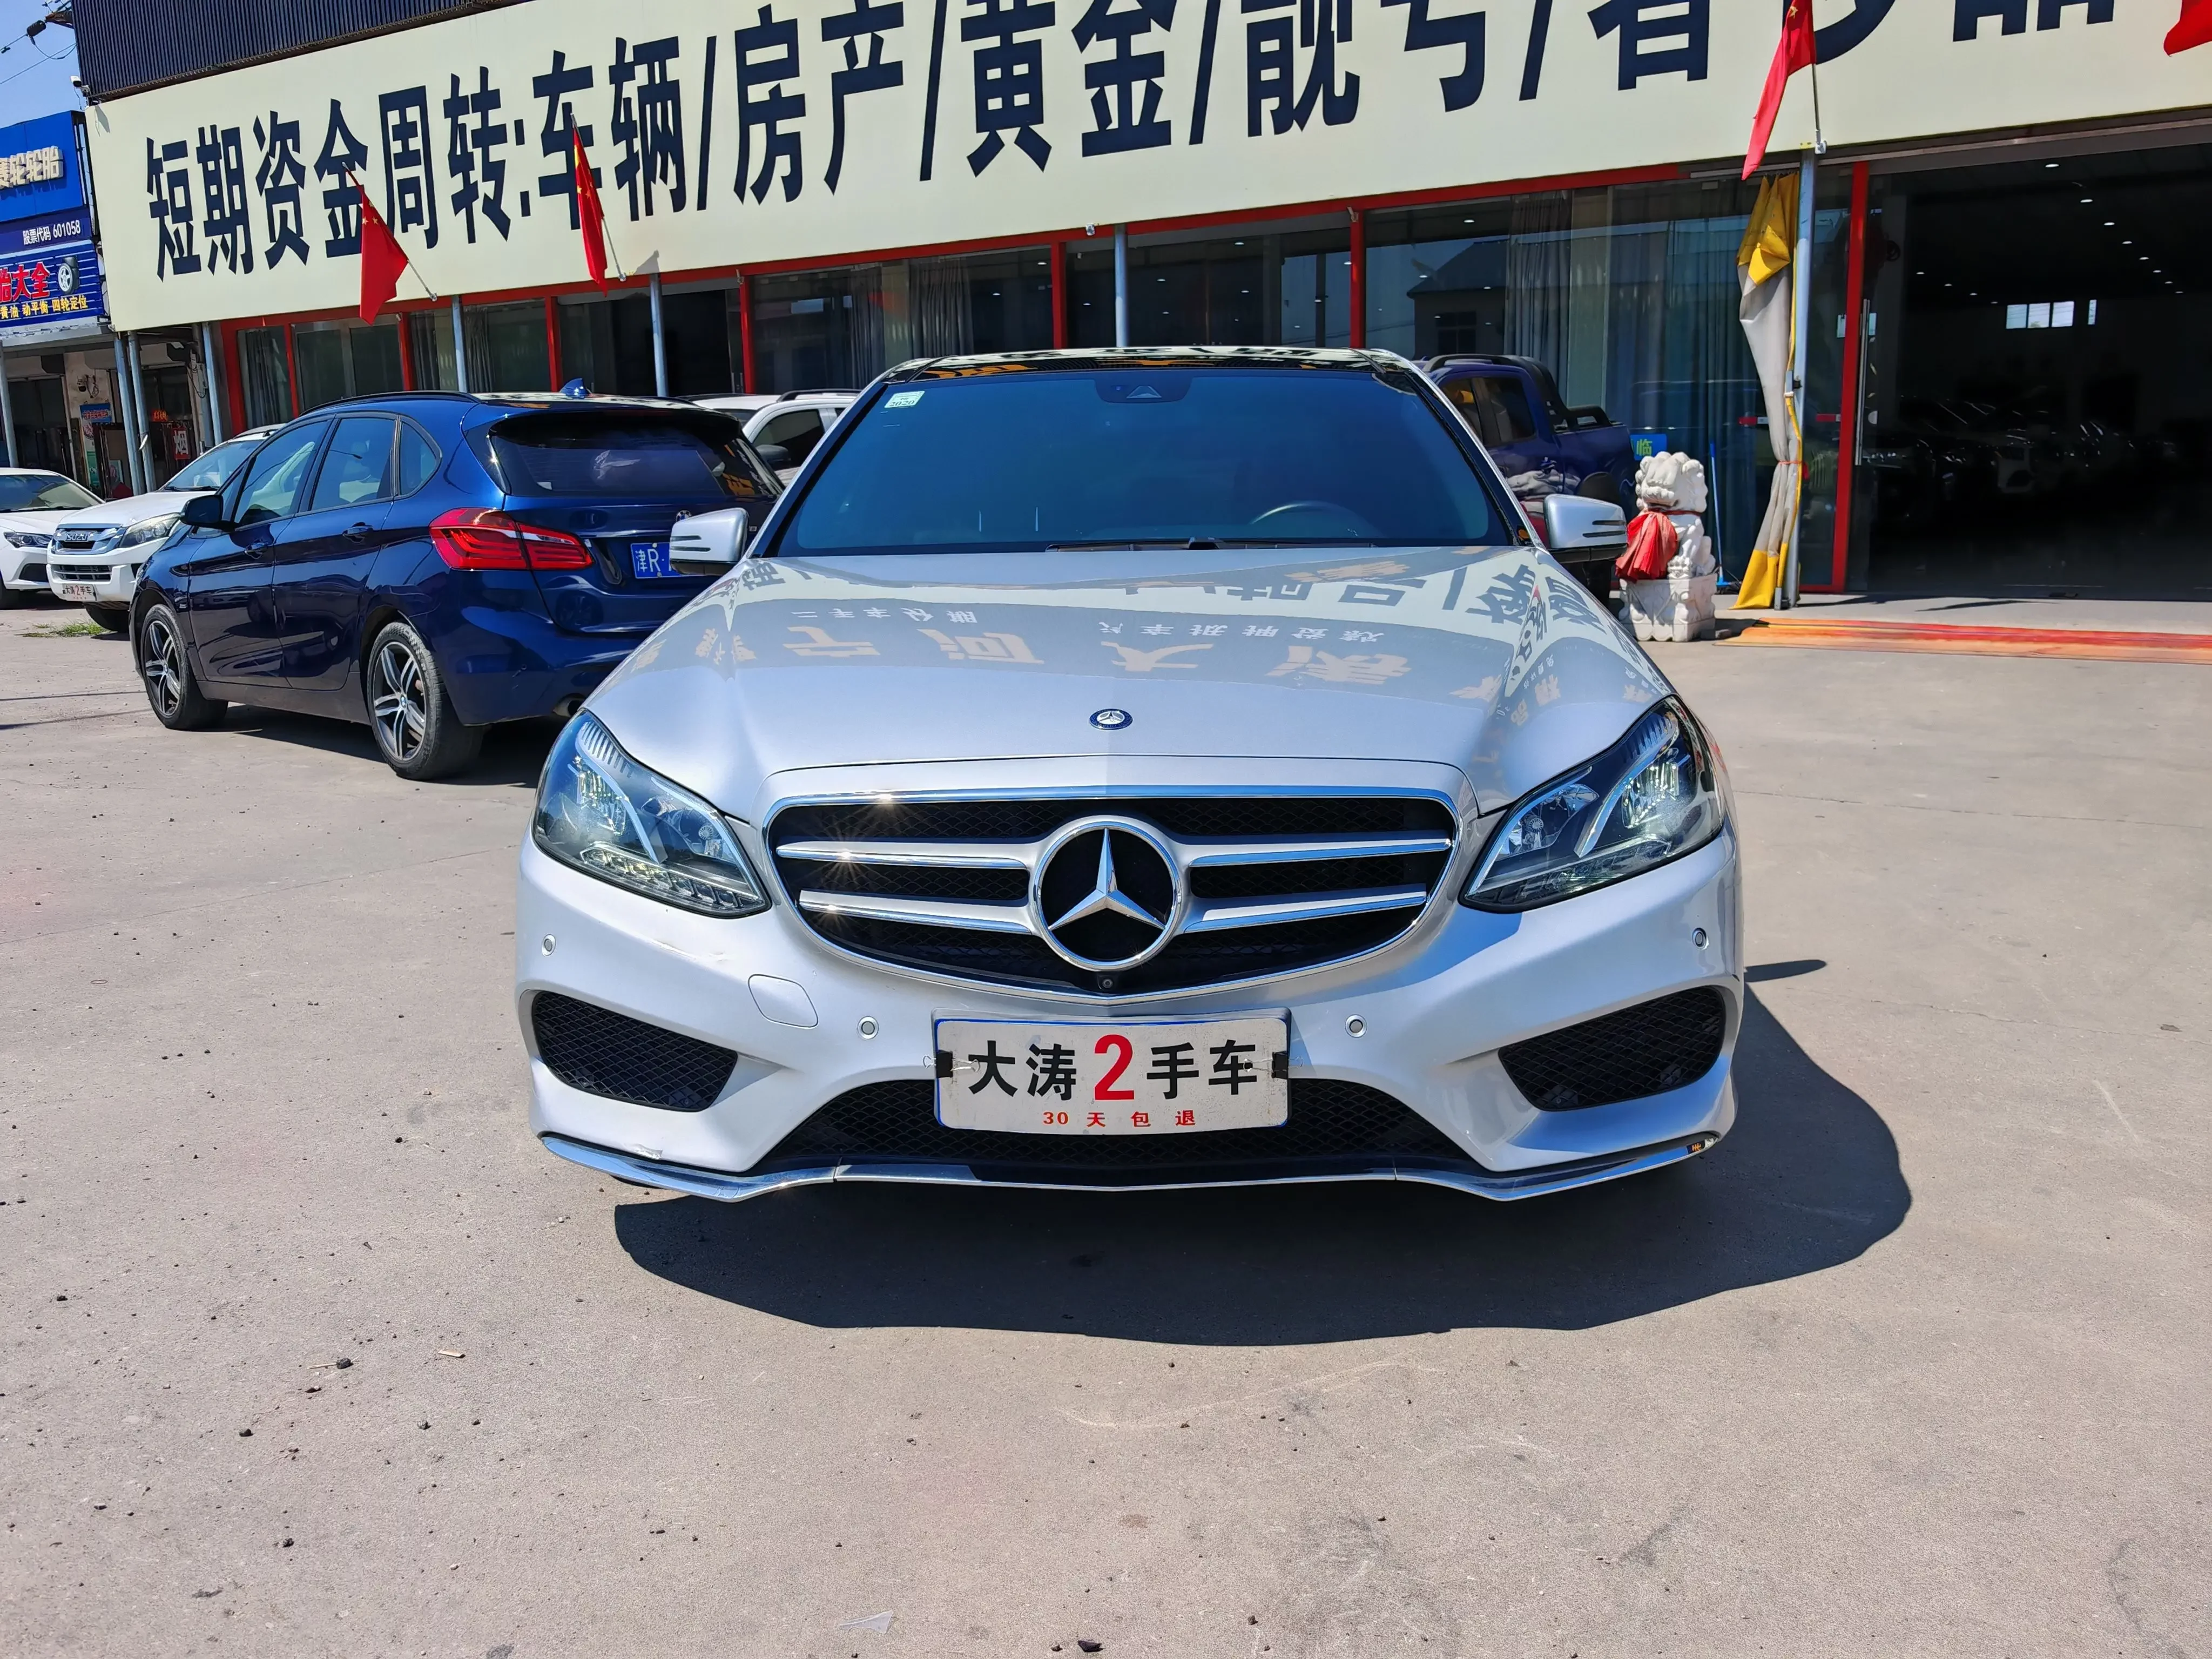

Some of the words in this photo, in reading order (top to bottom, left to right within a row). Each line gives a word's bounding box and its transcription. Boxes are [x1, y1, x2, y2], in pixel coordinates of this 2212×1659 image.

[23, 226, 51, 245] 股票代码
[53, 220, 80, 239] 601058
[22, 300, 48, 316] 动平衡
[52, 295, 88, 312] 四轮定位
[173, 430, 188, 455] 烟
[968, 1034, 1257, 1101] 大涛2手车
[1043, 1110, 1196, 1127] 30天包退
